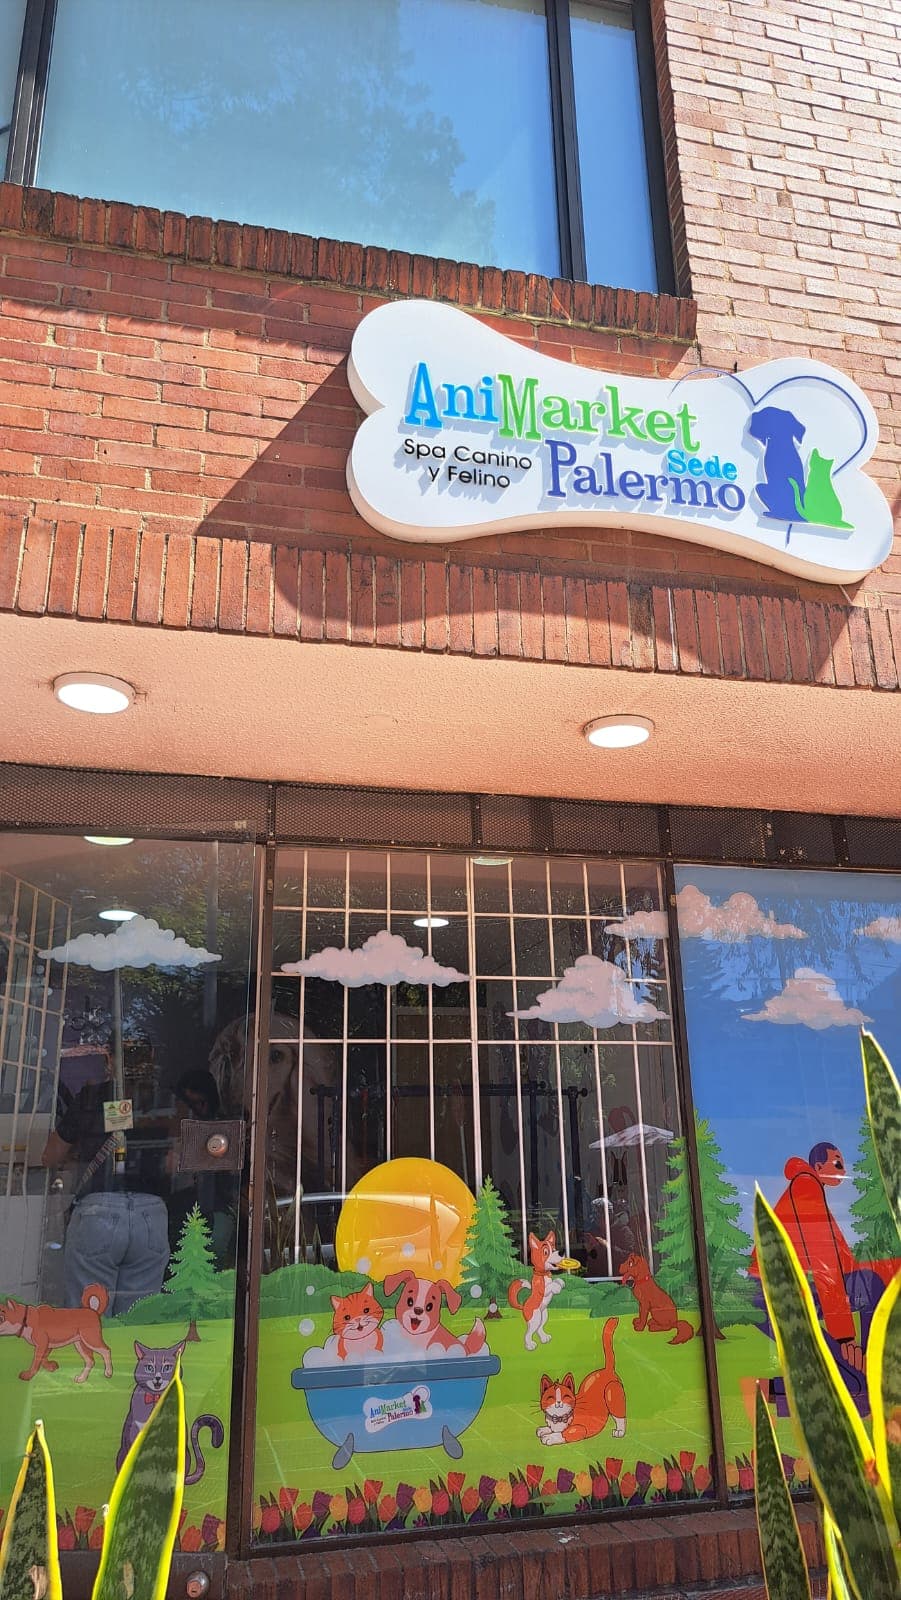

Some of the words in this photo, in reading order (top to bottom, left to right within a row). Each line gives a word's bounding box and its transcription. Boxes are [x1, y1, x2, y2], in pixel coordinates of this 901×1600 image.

[404, 362, 700, 453] AniMarket
[404, 438, 446, 461] Spa
[453, 444, 532, 470] Canino
[667, 449, 738, 481] Sede
[427, 466, 440, 483] y
[448, 465, 510, 488] Felino
[544, 439, 746, 513] Palermo
[370, 1400, 407, 1418] AniMarket
